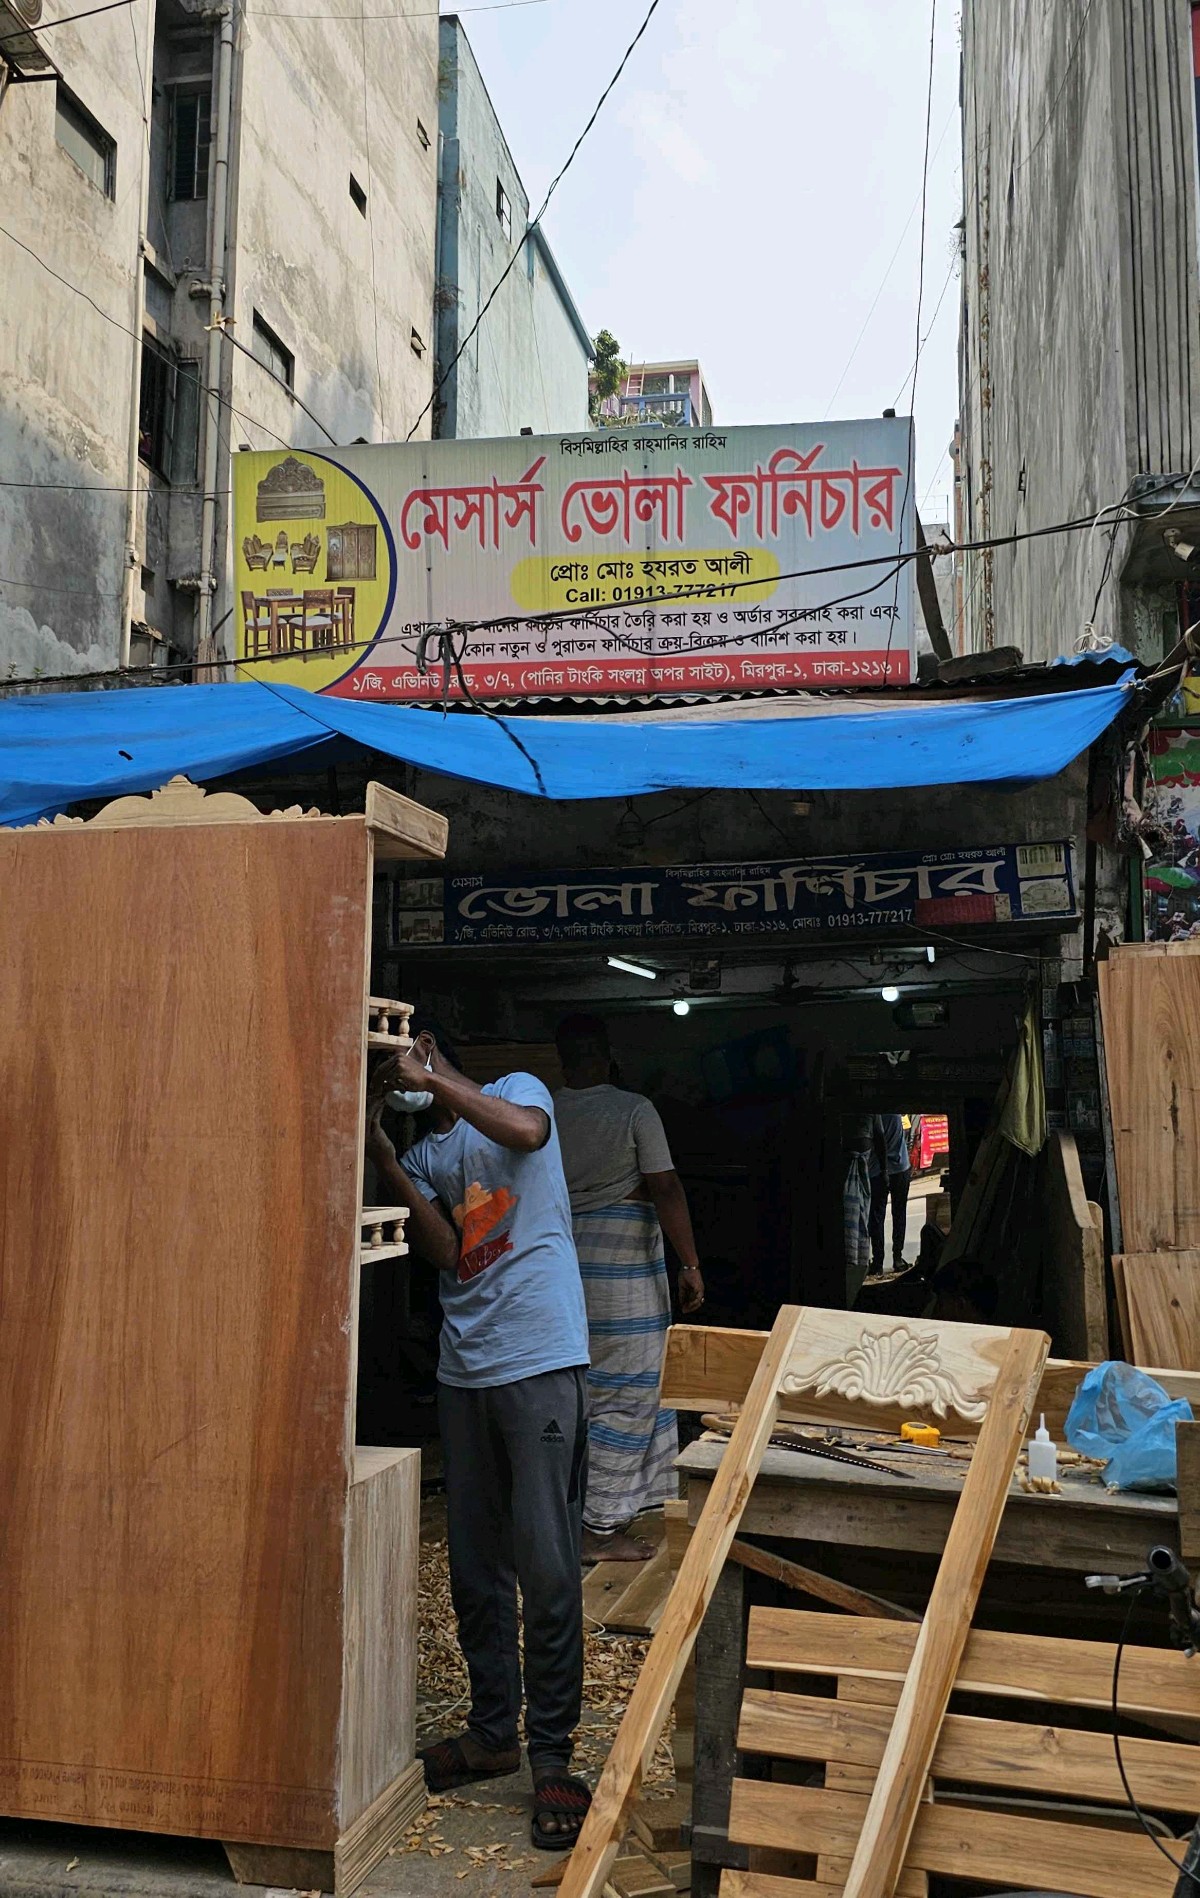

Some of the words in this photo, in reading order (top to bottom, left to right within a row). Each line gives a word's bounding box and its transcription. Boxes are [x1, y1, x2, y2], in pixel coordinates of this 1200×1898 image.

[692, 432, 727, 451] রাহিম
[401, 456, 546, 551] মেসার্স
[561, 465, 692, 544] ভোলা
[702, 444, 902, 540] ফার্নিচার
[551, 562, 588, 582] প্রোঃ
[597, 561, 634, 580] মোঃ
[640, 559, 698, 580] হযরত
[704, 551, 753, 576] আলী
[566, 588, 606, 603] Call:
[624, 610, 656, 632] তৈরি
[661, 612, 687, 627] করা
[692, 612, 712, 628] হয়
[718, 612, 728, 624] ও
[733, 605, 773, 624] অর্ডার
[836, 605, 865, 621] করা
[869, 605, 901, 620] এবং
[465, 641, 496, 657] কোন
[499, 641, 530, 660] নতুন
[535, 640, 546, 654] ও
[551, 638, 597, 658] পুরাতন
[750, 628, 790, 647] বার্নিশ
[794, 630, 823, 645] করা
[353, 673, 386, 693] ১/জি,
[392, 671, 441, 689] এভিনিউ
[484, 671, 515, 690] ৩/৭,
[520, 667, 564, 689] (পানির
[567, 665, 604, 685] টাংকি
[608, 668, 647, 686] সংলগ্ন
[650, 667, 685, 682] অপর
[689, 662, 736, 683] সাইট),
[740, 660, 807, 681] মিরপুর-১,
[457, 882, 660, 919] ভোলা
[680, 860, 1006, 912] ফার্নিচার
[827, 908, 912, 927] 01913-777217
